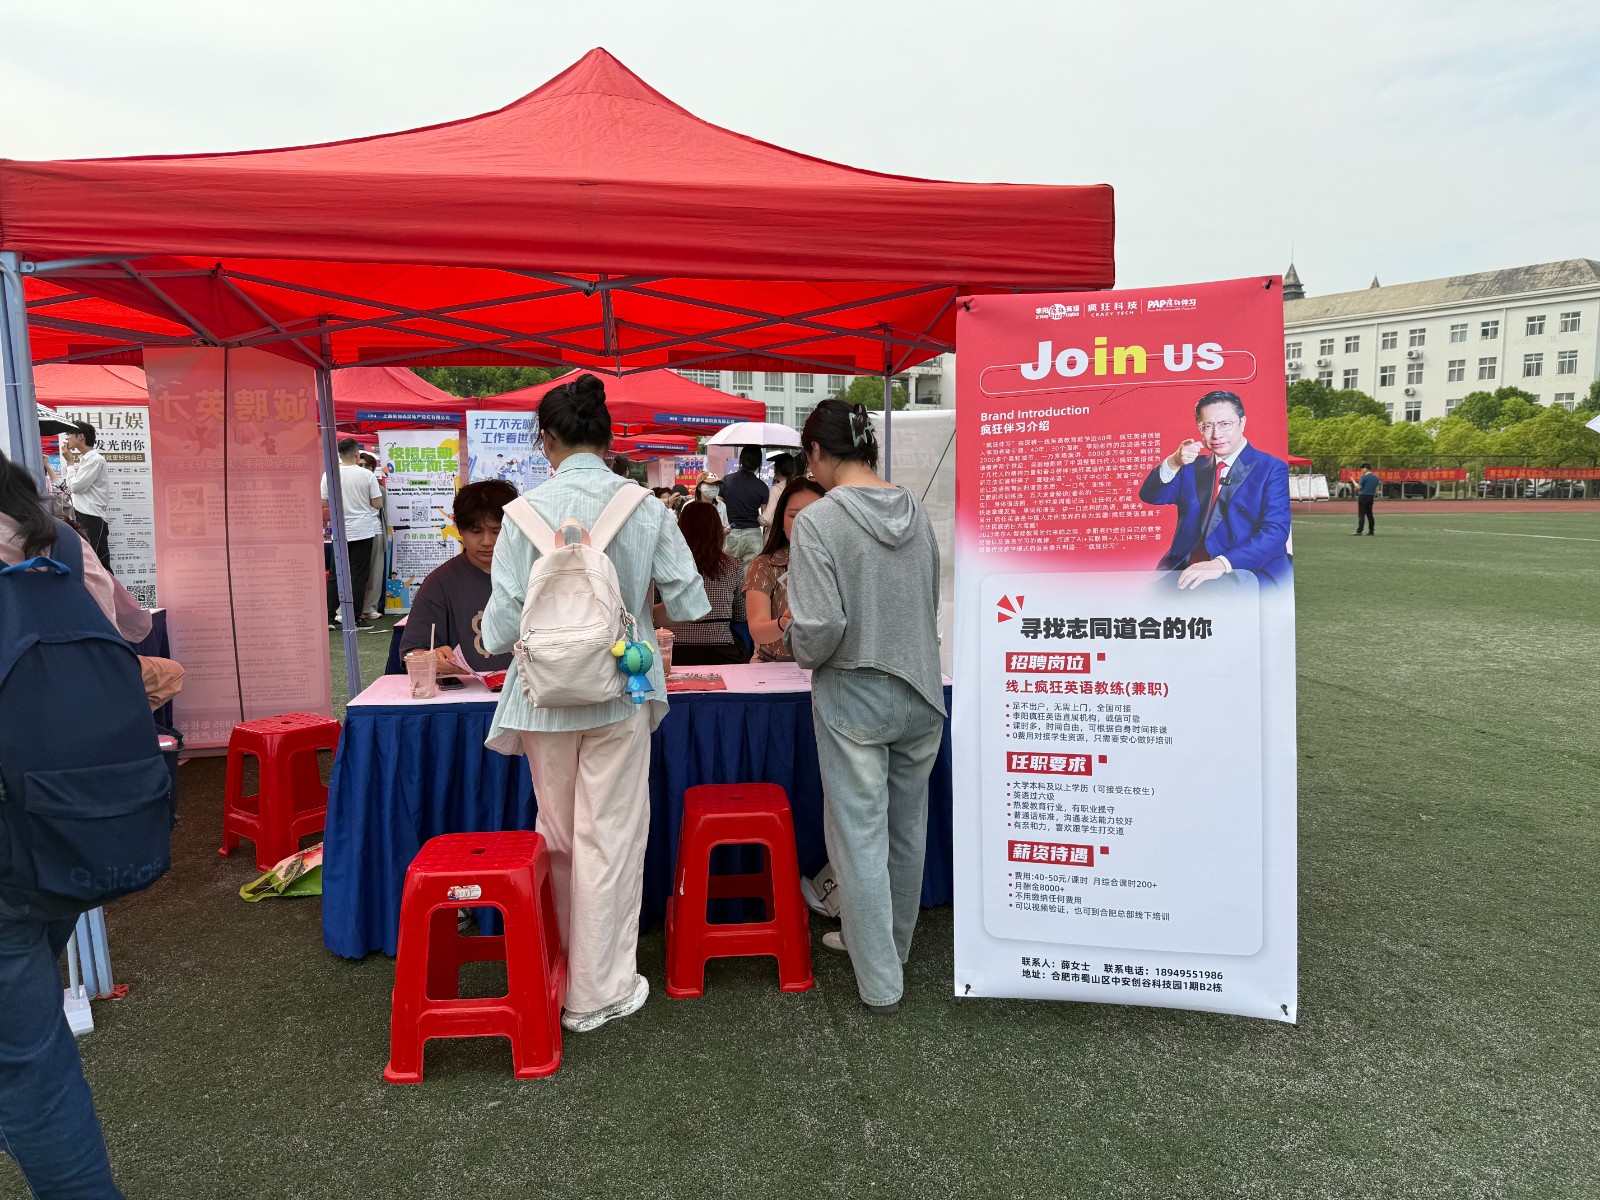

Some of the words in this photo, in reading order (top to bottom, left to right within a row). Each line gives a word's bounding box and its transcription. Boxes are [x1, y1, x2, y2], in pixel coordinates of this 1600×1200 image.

[1087, 301, 1138, 312] 疯狂科技
[1020, 336, 1147, 381] Join
[1163, 342, 1225, 372] us
[980, 410, 1014, 422] Brand
[1017, 405, 1090, 419] Introduction
[980, 420, 1050, 436] 疯狂伴习介绍
[388, 446, 453, 460] 校招启动
[395, 460, 459, 472] 职等你来
[1020, 617, 1213, 640] 寻找志同道合的你
[1010, 655, 1085, 671] 招聘岗位
[1005, 680, 1169, 697] 线上疯狂英语教练(兼职)
[1012, 702, 1131, 713] 足不出户，无需上门，全国可接
[1012, 712, 1141, 723] 李阳疯狂英语直属机构，诚信可靠
[1012, 722, 1168, 734] 课时多，时间自由，可根据自身时间排课
[1012, 733, 1173, 745] 0费用对接学生资源，只需要安心做好培训
[1011, 755, 1087, 772] 任职要求
[1013, 791, 1055, 801] 英语过六级
[1013, 801, 1115, 814] 热爱教育行业，有职业操守
[1014, 812, 1133, 825] 普通话标准，沟通表达能力较好
[1014, 822, 1125, 835] 有亲和力，喜欢跟学生打交道
[1013, 843, 1088, 863] 薪资待遇
[1014, 882, 1065, 893] 月酬金8000+
[1015, 892, 1082, 904] 不用缴纳任何费用
[1015, 902, 1170, 921] 可以视频验证，也可到合肥总部线下培训
[1021, 957, 1091, 972] 联系人：薛女士
[1103, 963, 1223, 980] 联系电话：18949551986
[1021, 969, 1223, 993] 地址：合肥市蜀山区中安创谷科技园1期B2栋
